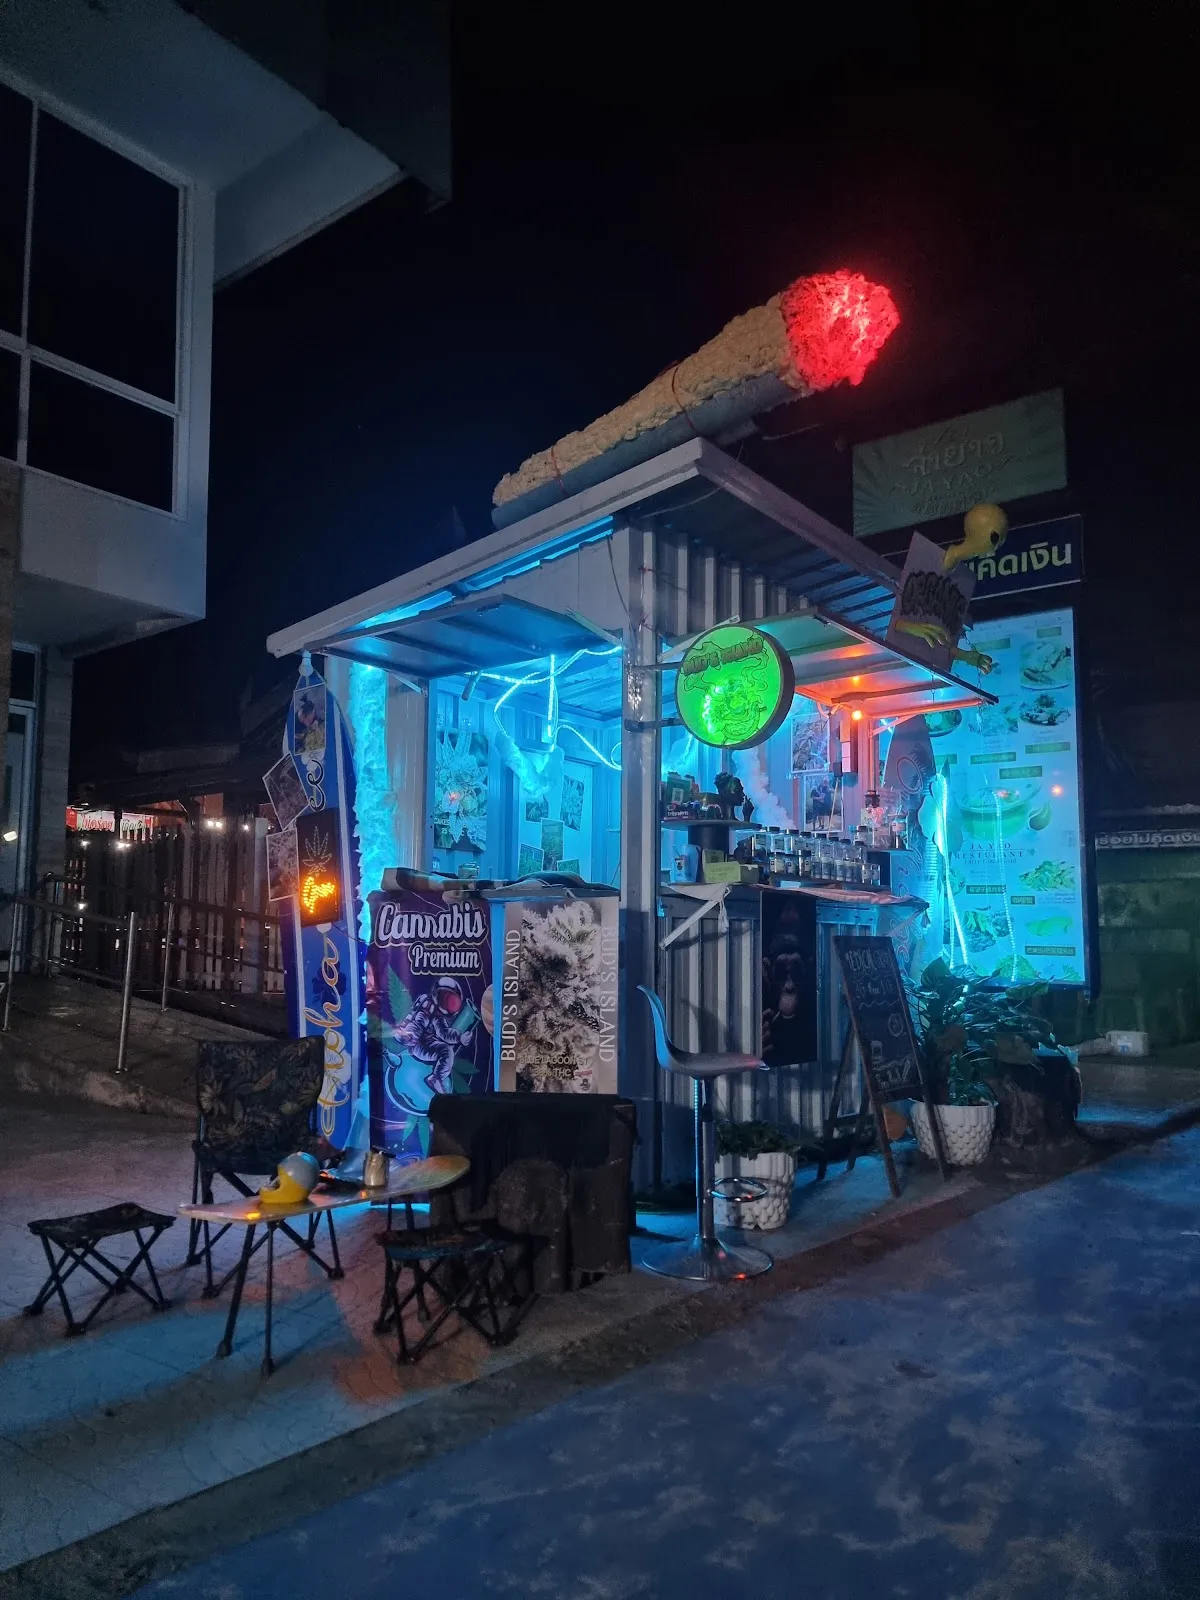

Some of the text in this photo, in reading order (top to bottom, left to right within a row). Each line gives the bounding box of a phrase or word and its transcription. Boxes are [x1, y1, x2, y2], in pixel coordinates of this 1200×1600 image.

[378, 902, 486, 942] Cannabis
[411, 944, 480, 969] Premium
[501, 929, 521, 1061] BUD'S ISLAND
[599, 927, 617, 1062] BUD'S ISLAND
[553, 1068, 571, 1077] THC
